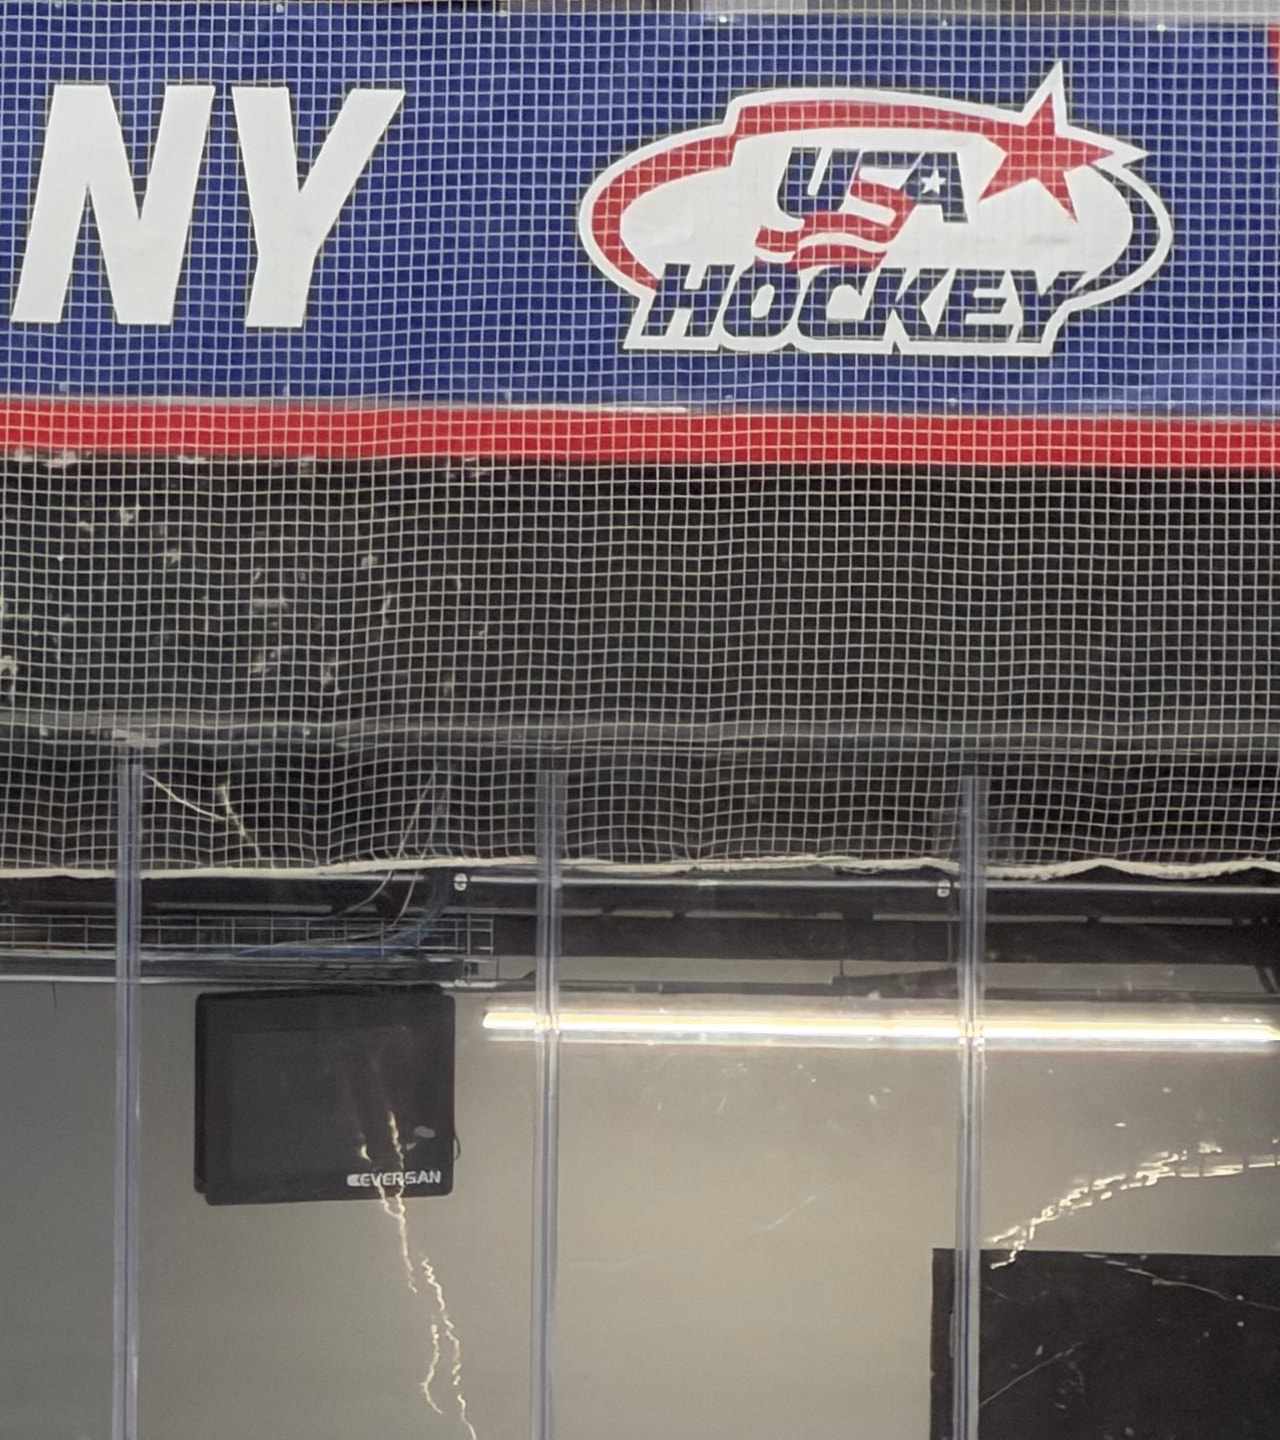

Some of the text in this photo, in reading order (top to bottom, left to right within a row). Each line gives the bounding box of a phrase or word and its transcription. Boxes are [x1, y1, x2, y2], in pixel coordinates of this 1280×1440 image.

[8, 82, 406, 330] NY
[777, 146, 970, 224] USA
[636, 262, 1080, 344] HOCKEY
[360, 1170, 442, 1186] EVERSAN
